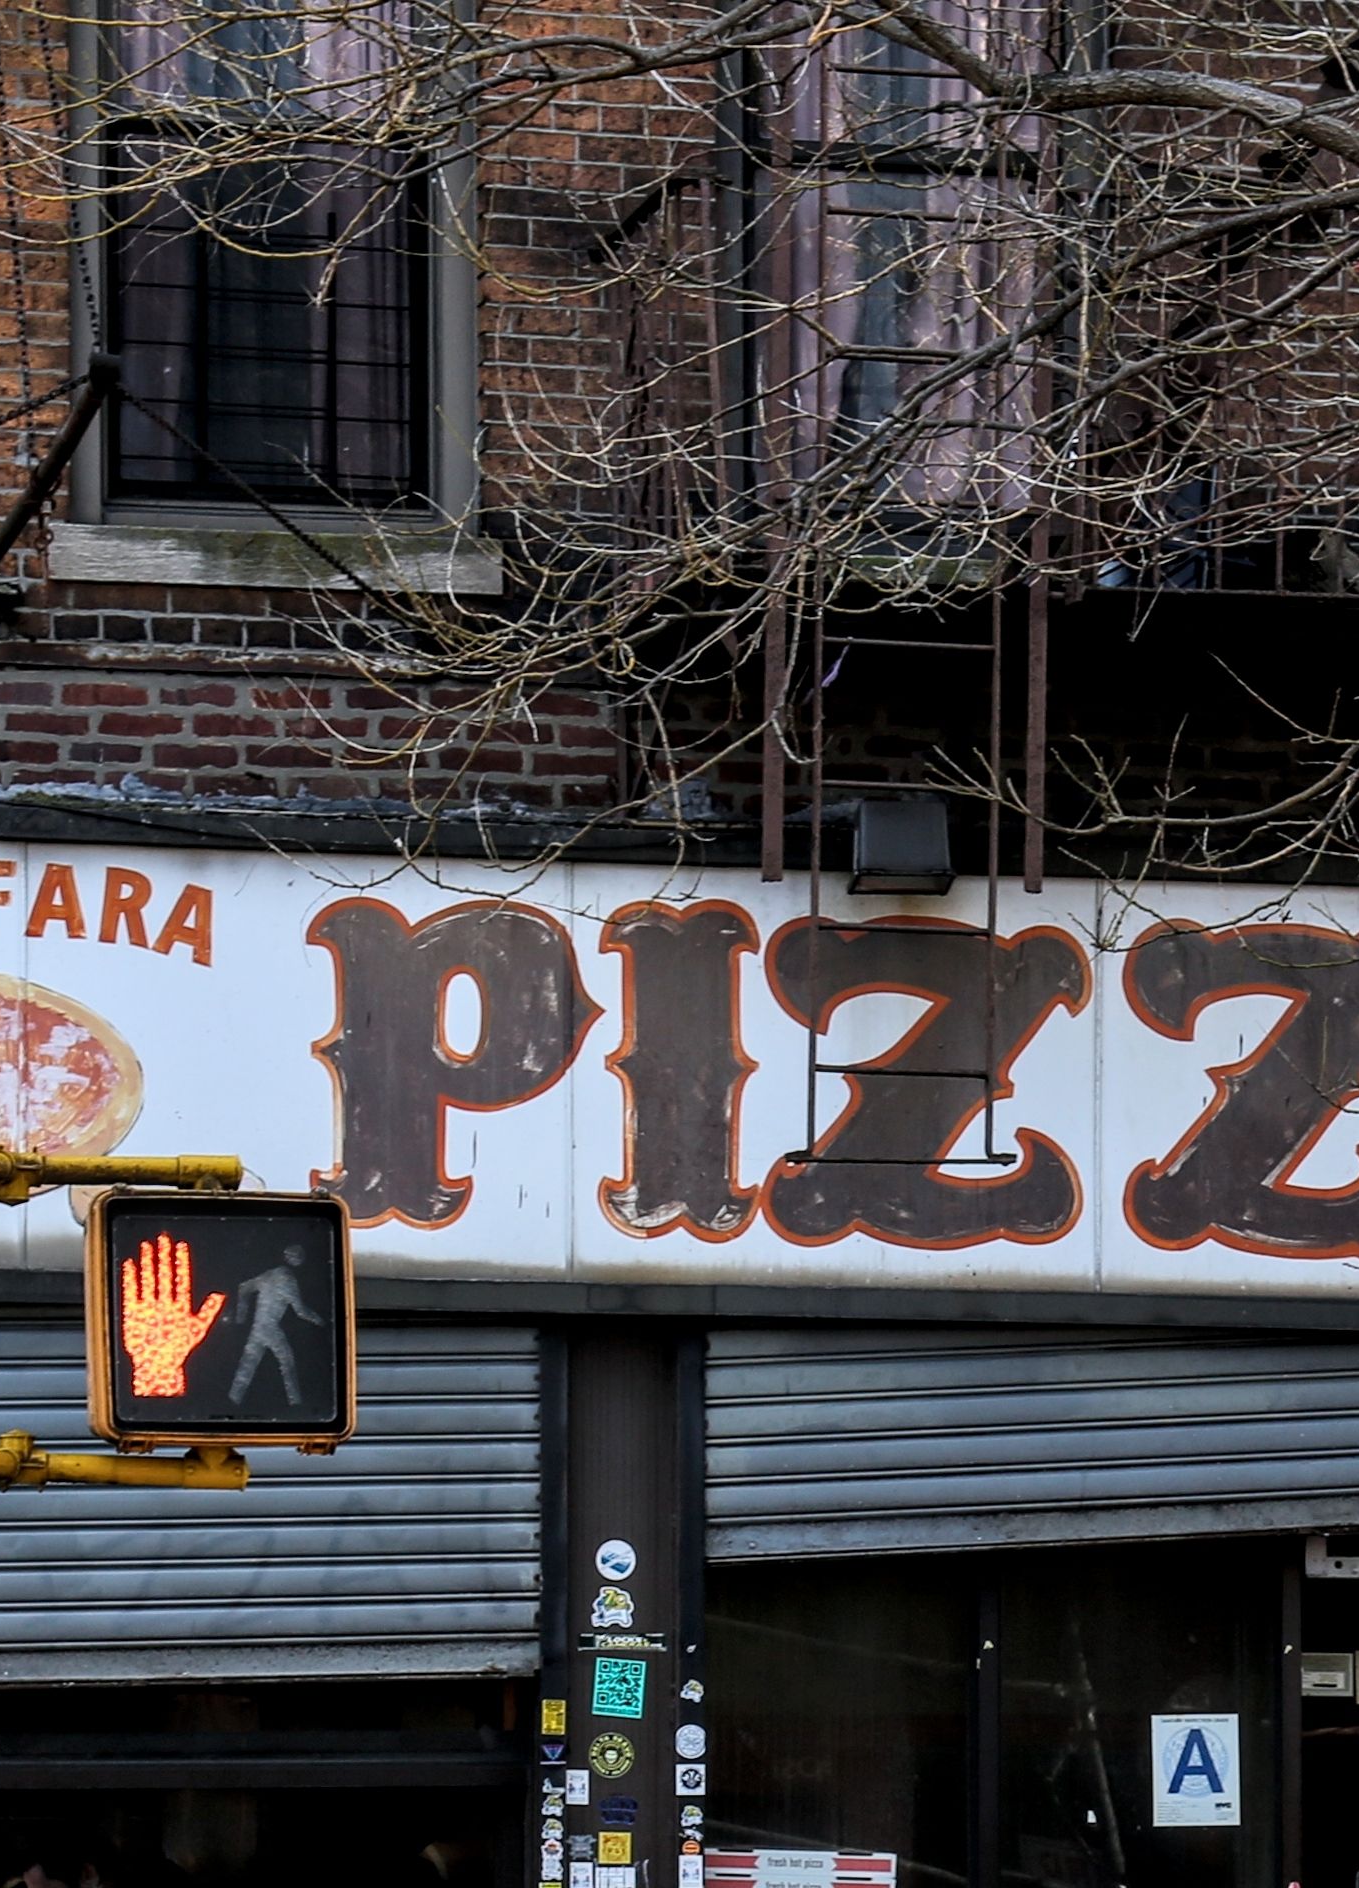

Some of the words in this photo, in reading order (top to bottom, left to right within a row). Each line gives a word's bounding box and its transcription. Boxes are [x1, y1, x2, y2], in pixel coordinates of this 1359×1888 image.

[1168, 1729, 1225, 1794] A
[767, 1857, 787, 1867] fresh
[789, 1857, 802, 1868] hot
[804, 1858, 823, 1870] pizza
